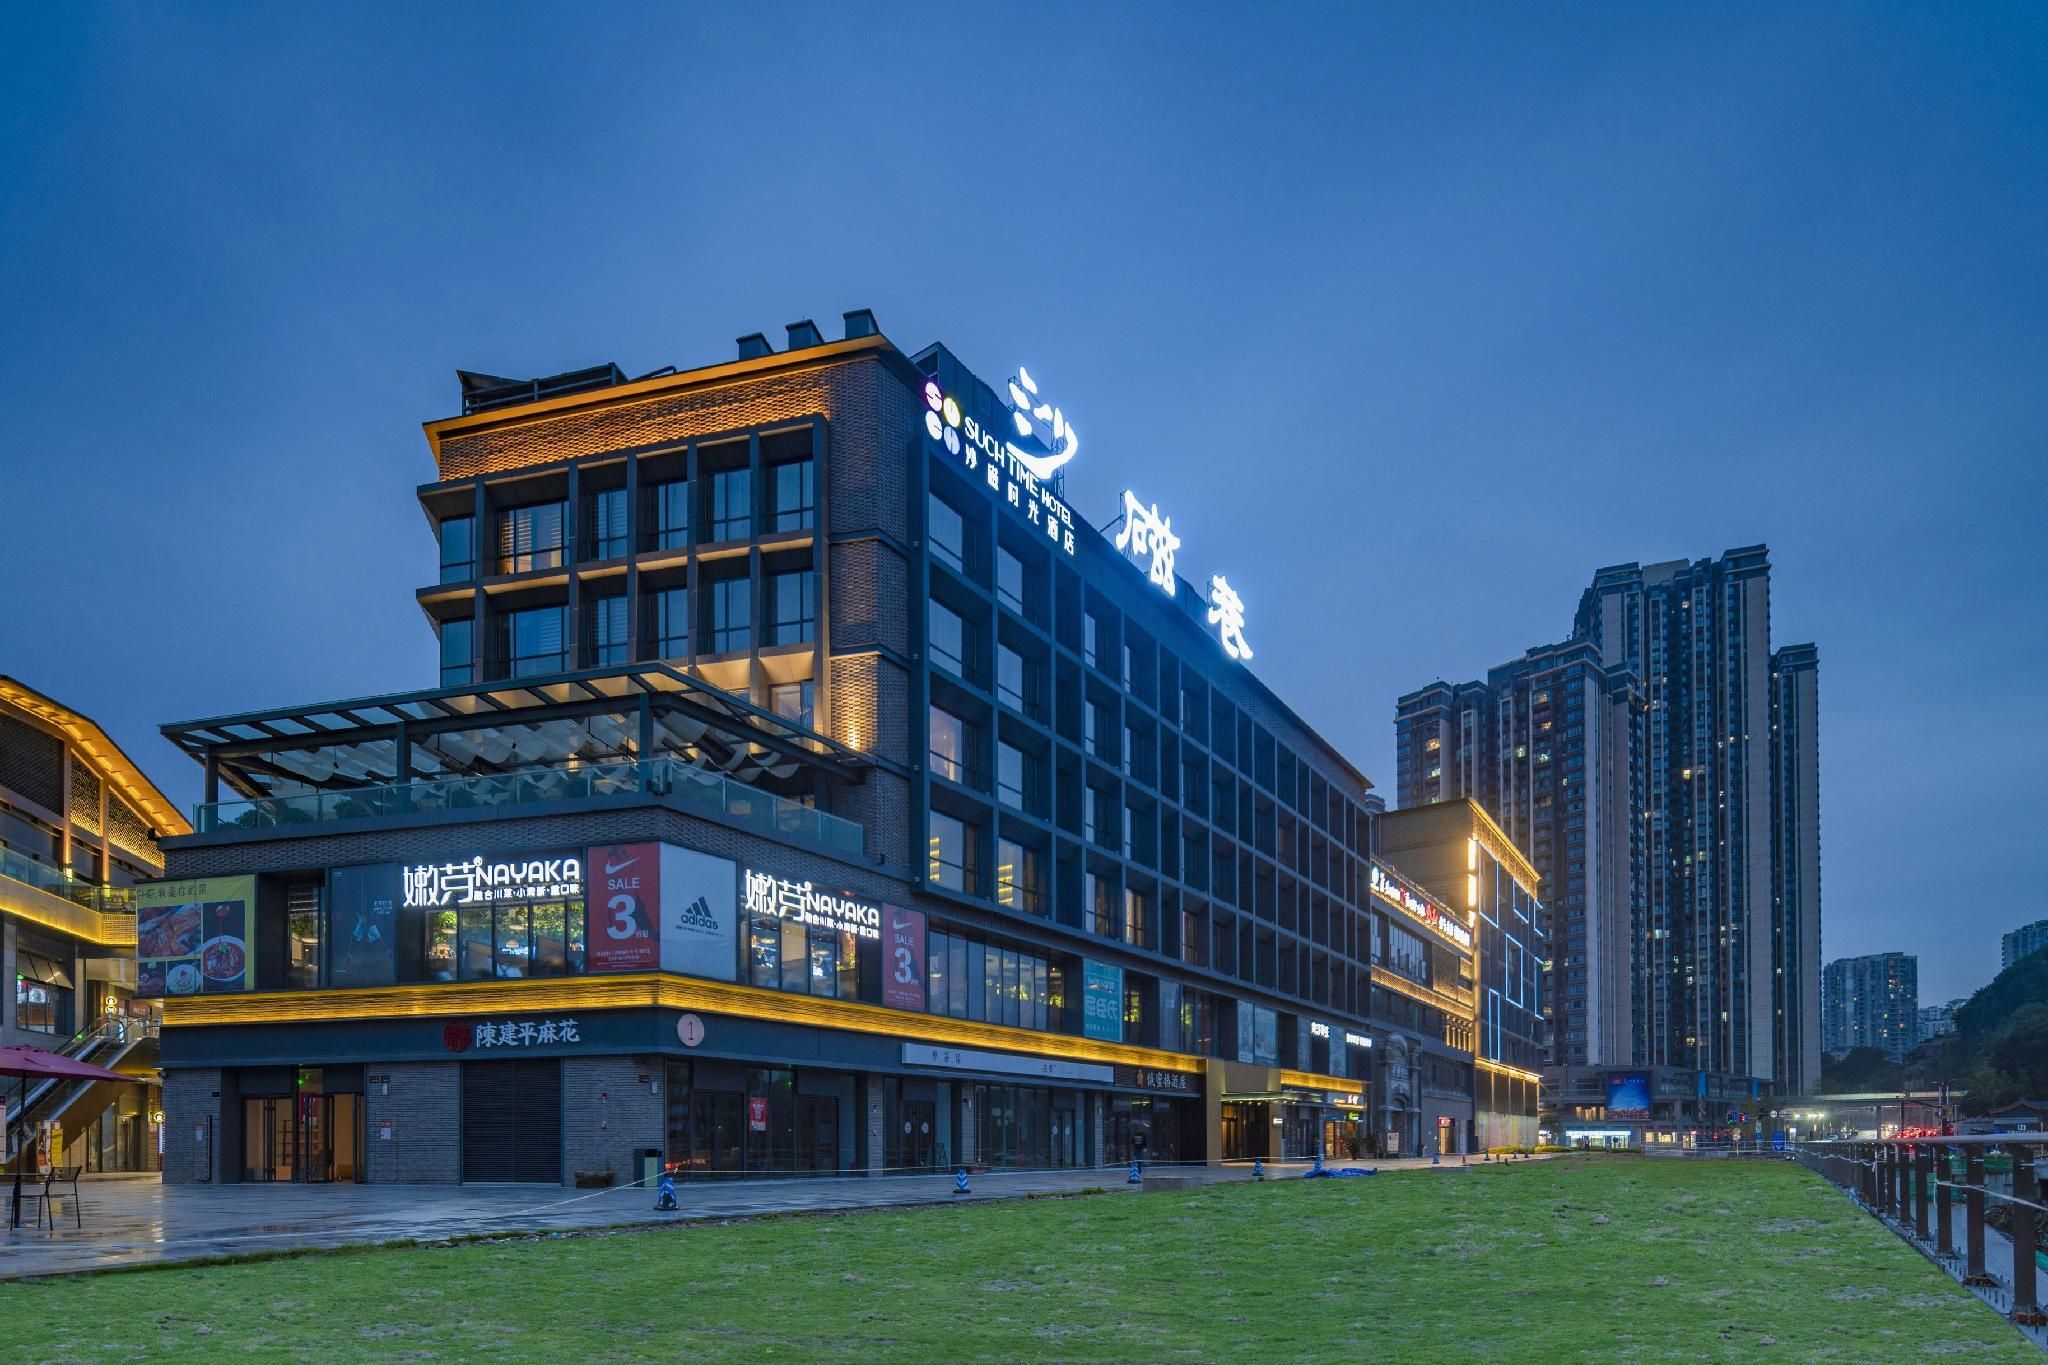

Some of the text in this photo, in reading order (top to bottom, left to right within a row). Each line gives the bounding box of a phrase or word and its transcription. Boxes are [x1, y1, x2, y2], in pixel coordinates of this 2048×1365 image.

[964, 416, 1075, 530] SUCH TIME HOTEL
[402, 861, 476, 908] 嫩芽
[475, 858, 581, 888] NAYAKA
[607, 877, 641, 891] SALE
[744, 868, 807, 922] 嫩芽
[805, 891, 880, 928] NAYAKA
[606, 894, 637, 940] 3
[680, 913, 719, 930] adidas
[894, 933, 914, 946] SALE
[894, 947, 912, 984] 3
[1085, 995, 1118, 1020] 屈臣氏
[475, 1018, 581, 1049] 陳建平麻花
